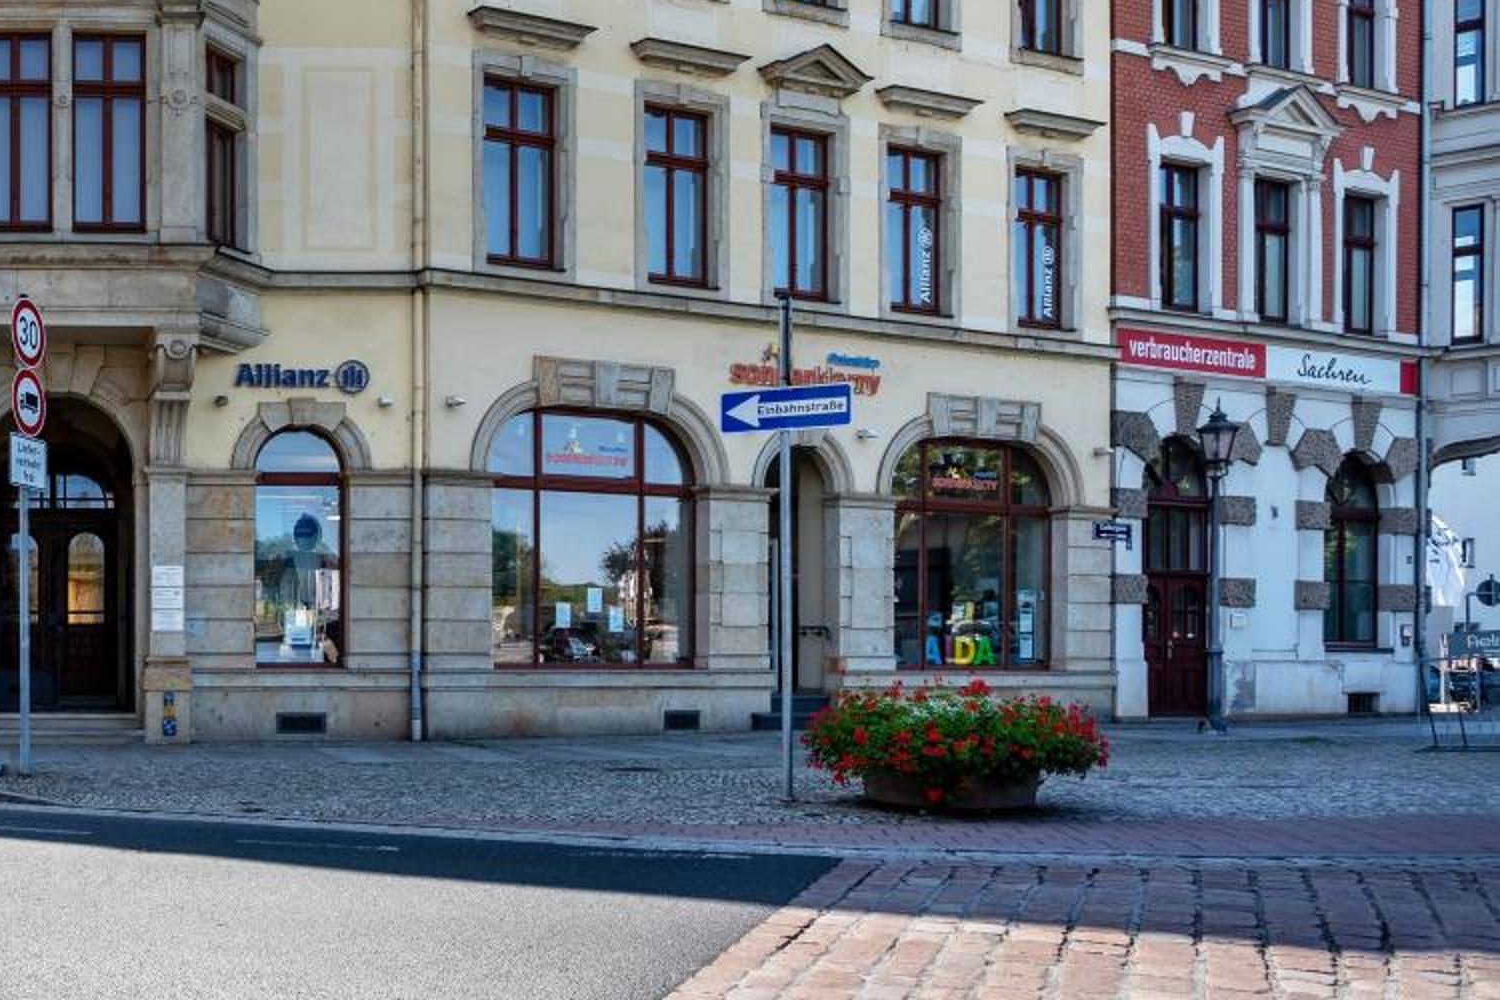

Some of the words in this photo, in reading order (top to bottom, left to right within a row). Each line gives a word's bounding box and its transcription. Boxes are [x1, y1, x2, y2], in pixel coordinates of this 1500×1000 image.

[917, 251, 933, 304] Allianz
[1040, 267, 1055, 318] Allianz
[19, 315, 39, 350] 30
[1129, 337, 1256, 371] verbraucherzentrale
[1296, 353, 1372, 385] Sachsen
[235, 363, 331, 388] Allianz
[757, 399, 845, 416] Einbahnstraße
